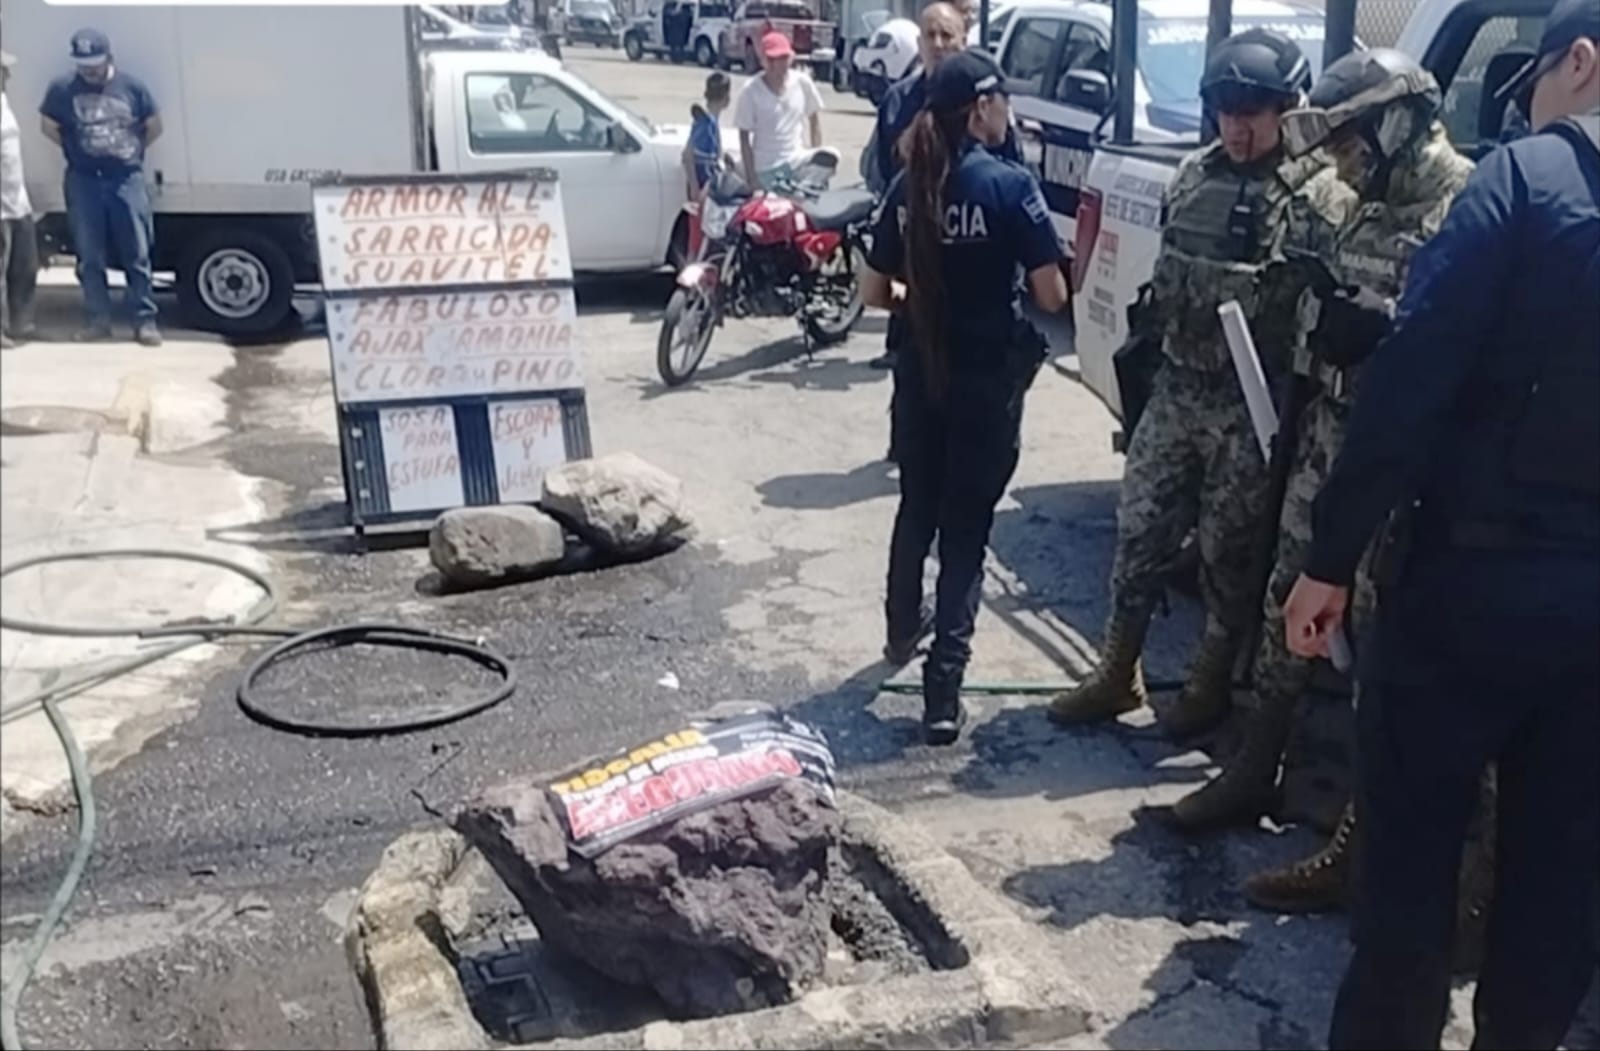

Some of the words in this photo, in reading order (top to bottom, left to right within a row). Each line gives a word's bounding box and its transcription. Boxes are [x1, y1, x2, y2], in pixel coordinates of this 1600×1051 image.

[339, 183, 469, 218] ARMOR
[477, 182, 542, 215] ALL
[896, 201, 988, 237] PCÍA
[344, 222, 552, 256] SARRICIDA
[344, 254, 550, 285] SUAVITEL
[352, 291, 561, 325] FABULOSO
[349, 328, 428, 355] AJAX
[492, 359, 575, 386] PINO
[385, 406, 448, 433] SOSA
[401, 427, 453, 452] PARA
[387, 454, 459, 491] ESTUFA
